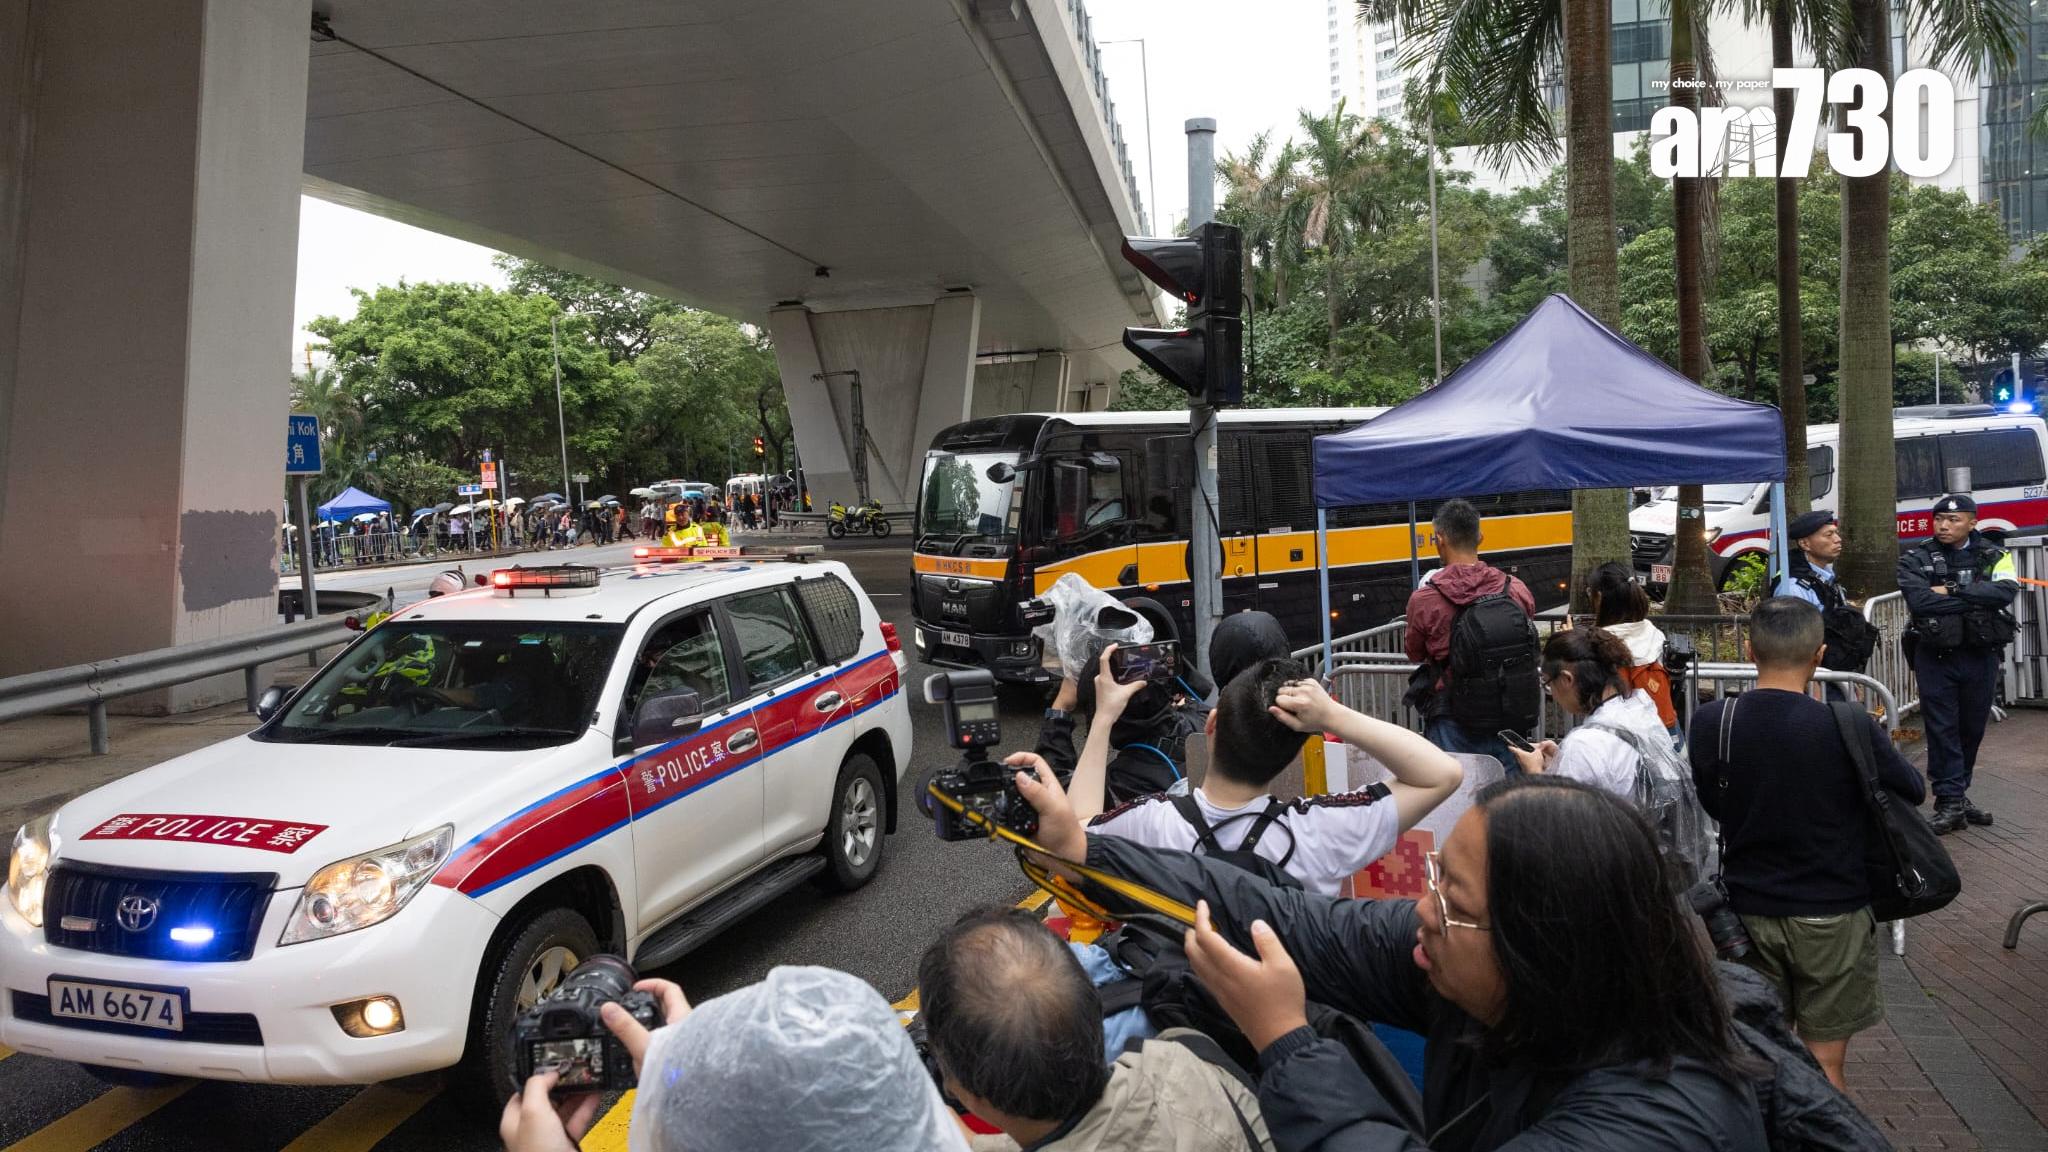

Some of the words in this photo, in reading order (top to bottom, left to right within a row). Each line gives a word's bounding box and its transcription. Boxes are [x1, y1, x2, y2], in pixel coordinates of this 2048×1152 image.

[297, 421, 316, 436] Kok
[1897, 519, 1915, 533] ICE
[942, 601, 967, 615] MAN
[641, 769, 657, 794] 警
[656, 746, 711, 788] POLICE
[710, 740, 726, 762] 察
[95, 816, 141, 836] 警
[129, 817, 274, 843] POLICE
[266, 826, 315, 848] 察
[60, 986, 95, 1016] AM
[103, 991, 173, 1026] 6674
